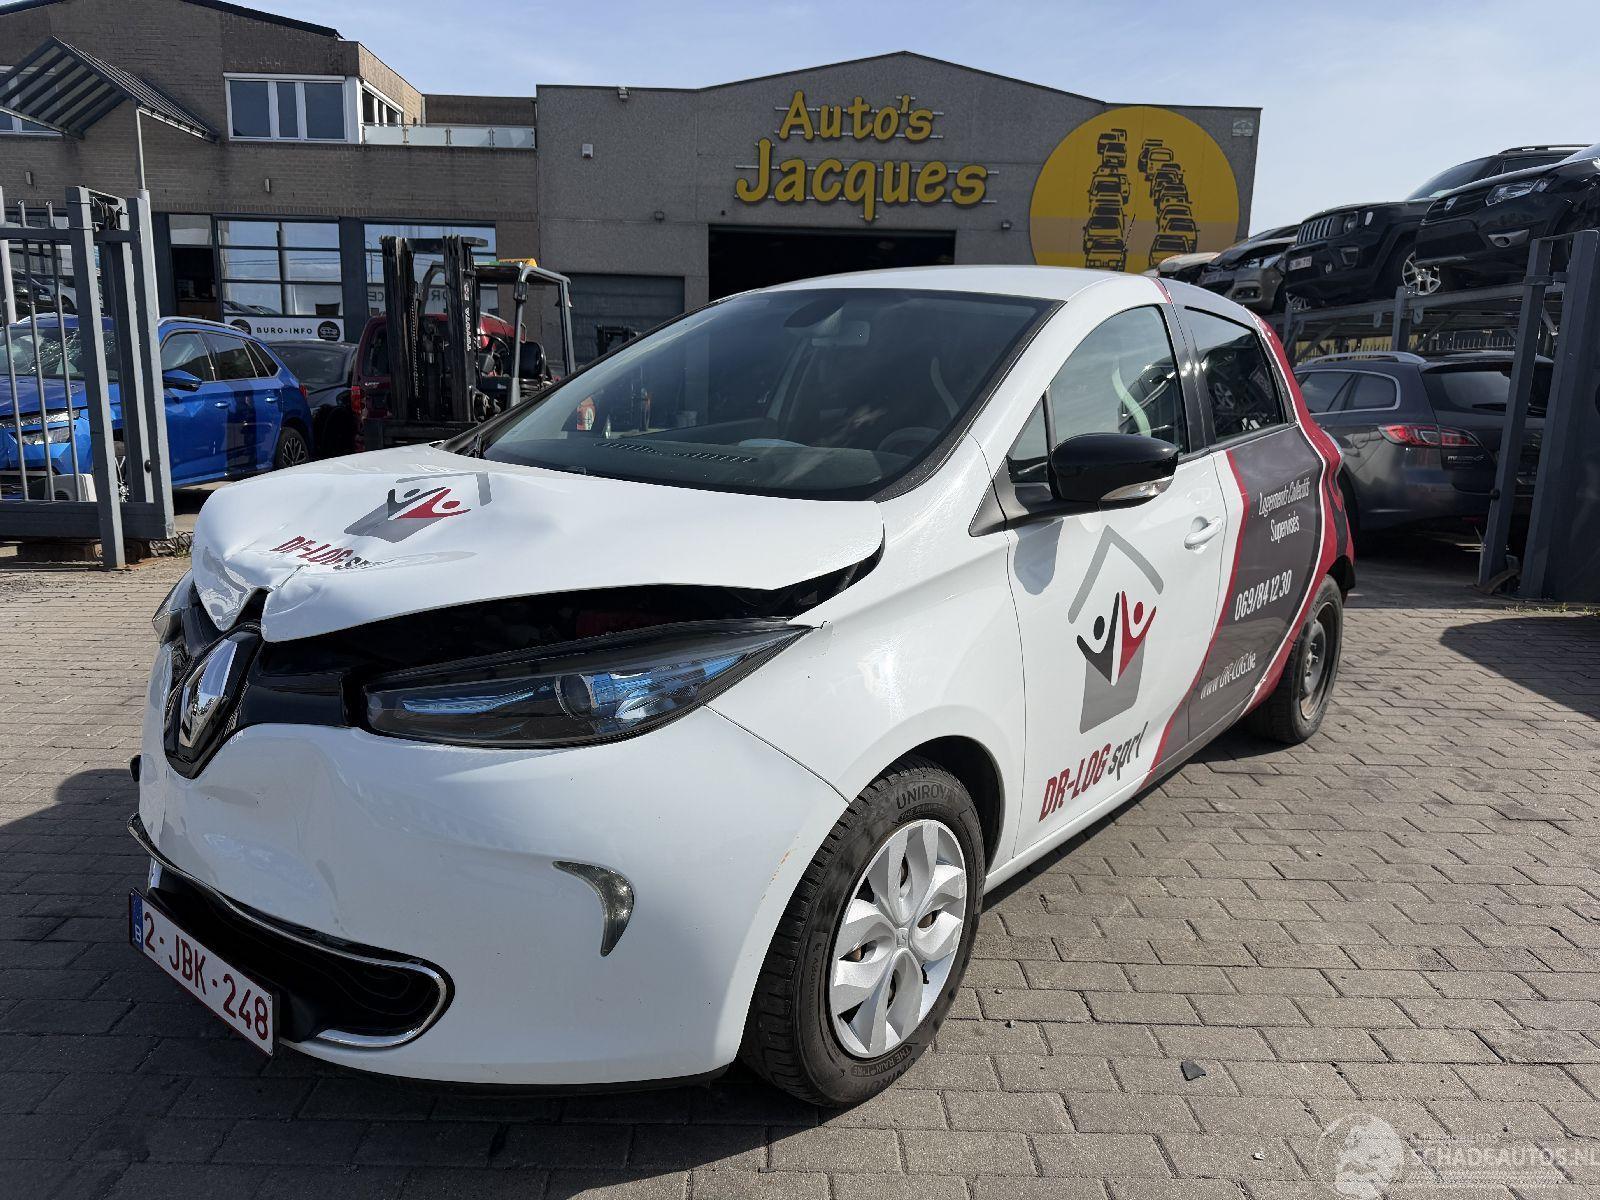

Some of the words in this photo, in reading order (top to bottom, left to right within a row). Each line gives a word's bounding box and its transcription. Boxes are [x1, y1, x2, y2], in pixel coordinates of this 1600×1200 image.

[779, 89, 934, 141] Auto's
[736, 138, 987, 222] Jacques
[256, 327, 313, 335] BURO-INFO
[1234, 579, 1269, 621] 069/84
[1279, 569, 1292, 598] 30
[1039, 743, 1111, 822] DR-LOG
[1107, 721, 1148, 781] sprl
[134, 924, 142, 944] B
